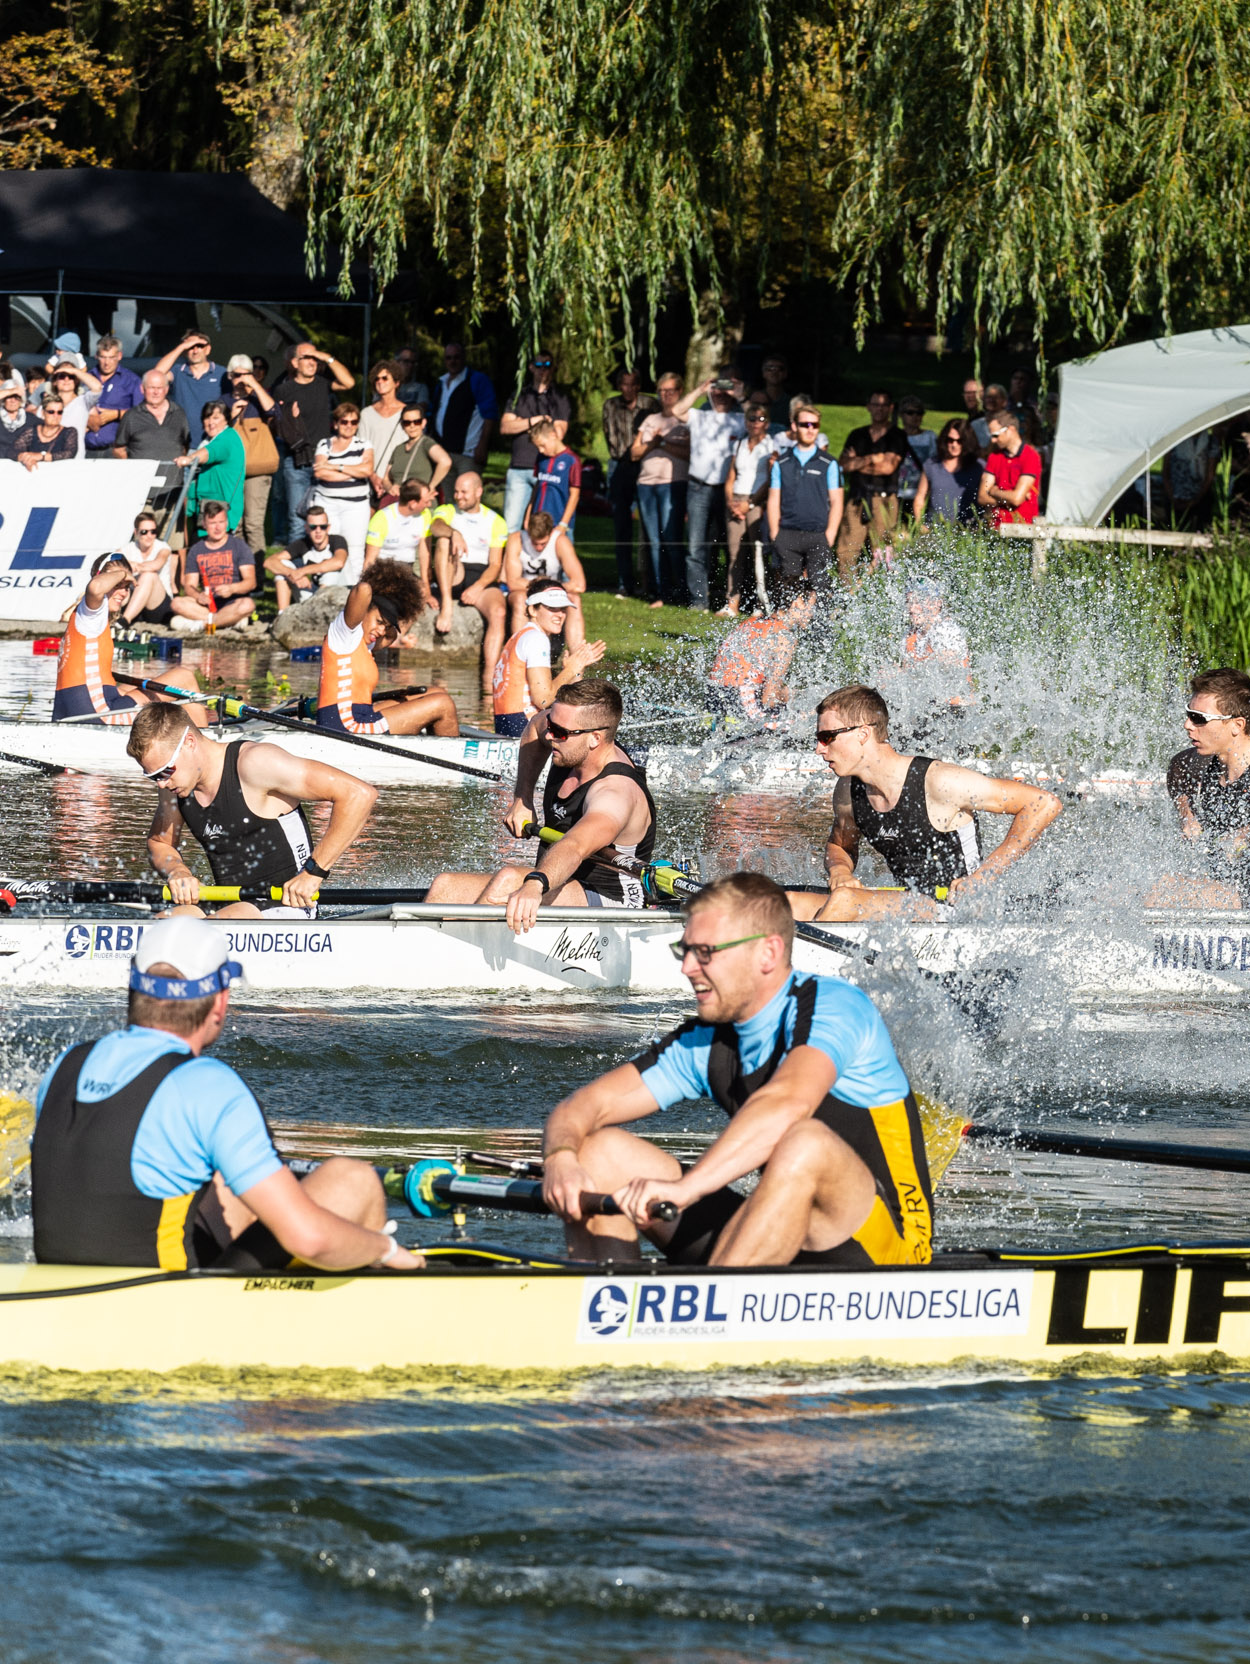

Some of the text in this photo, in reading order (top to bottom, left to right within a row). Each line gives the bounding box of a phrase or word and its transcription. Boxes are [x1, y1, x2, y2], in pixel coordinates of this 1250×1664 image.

[0, 507, 86, 570] L
[226, 933, 333, 953] BUNDESLIGA
[167, 982, 188, 997] NK
[198, 976, 215, 995] NK
[899, 1182, 925, 1212] RV
[637, 1284, 1020, 1323] RBL RUDER-BUNDESLIGA
